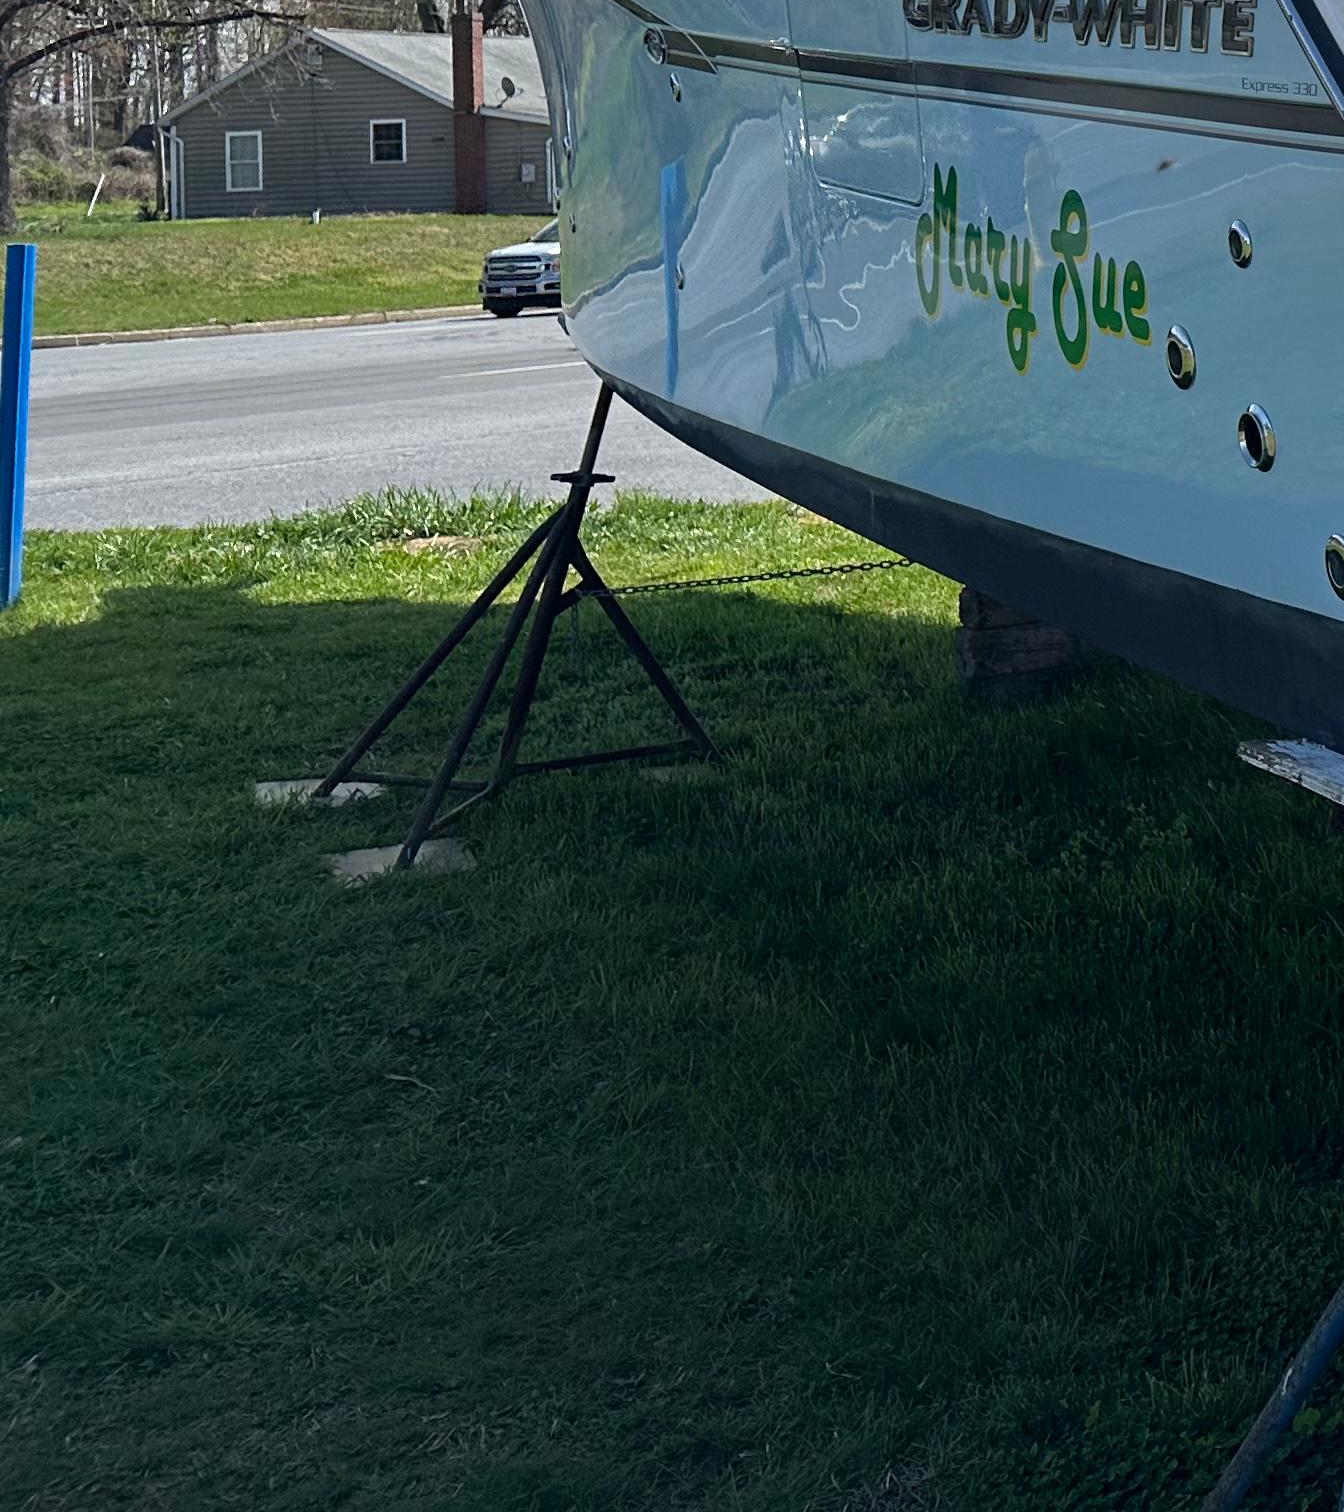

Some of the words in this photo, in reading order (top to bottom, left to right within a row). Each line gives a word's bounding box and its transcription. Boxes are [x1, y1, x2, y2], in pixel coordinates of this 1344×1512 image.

[1241, 77, 1289, 94] Express
[1292, 81, 1318, 97] 330
[915, 162, 1036, 375] Mary
[1050, 189, 1152, 372] Sue
